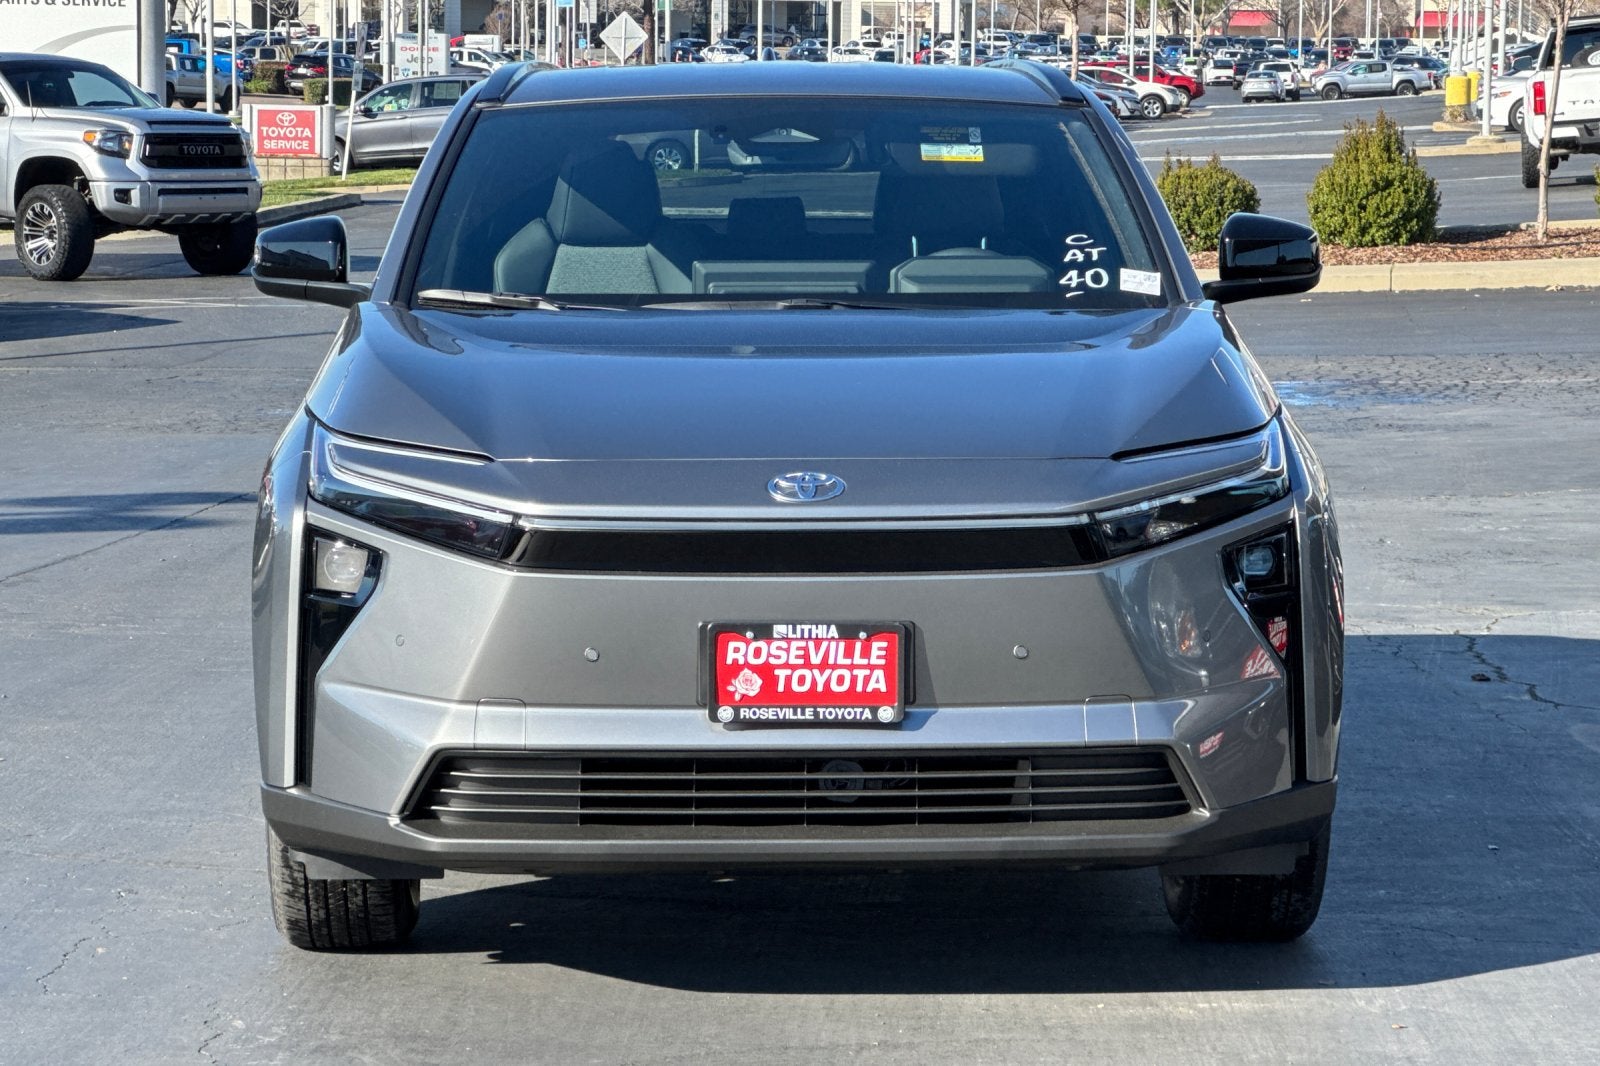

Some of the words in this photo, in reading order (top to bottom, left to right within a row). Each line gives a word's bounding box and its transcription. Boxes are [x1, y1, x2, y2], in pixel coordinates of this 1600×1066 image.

[261, 126, 312, 138] TOYOTA
[183, 145, 221, 155] TOYOTA
[263, 139, 309, 150] SERVICE
[1059, 268, 1109, 288] 40
[788, 625, 839, 639] LITHIA
[725, 640, 889, 665] ROSEVILLE
[774, 668, 889, 693] TOYOTA
[740, 708, 815, 719] ROSEVILLE
[817, 708, 872, 720] TOYOTA
